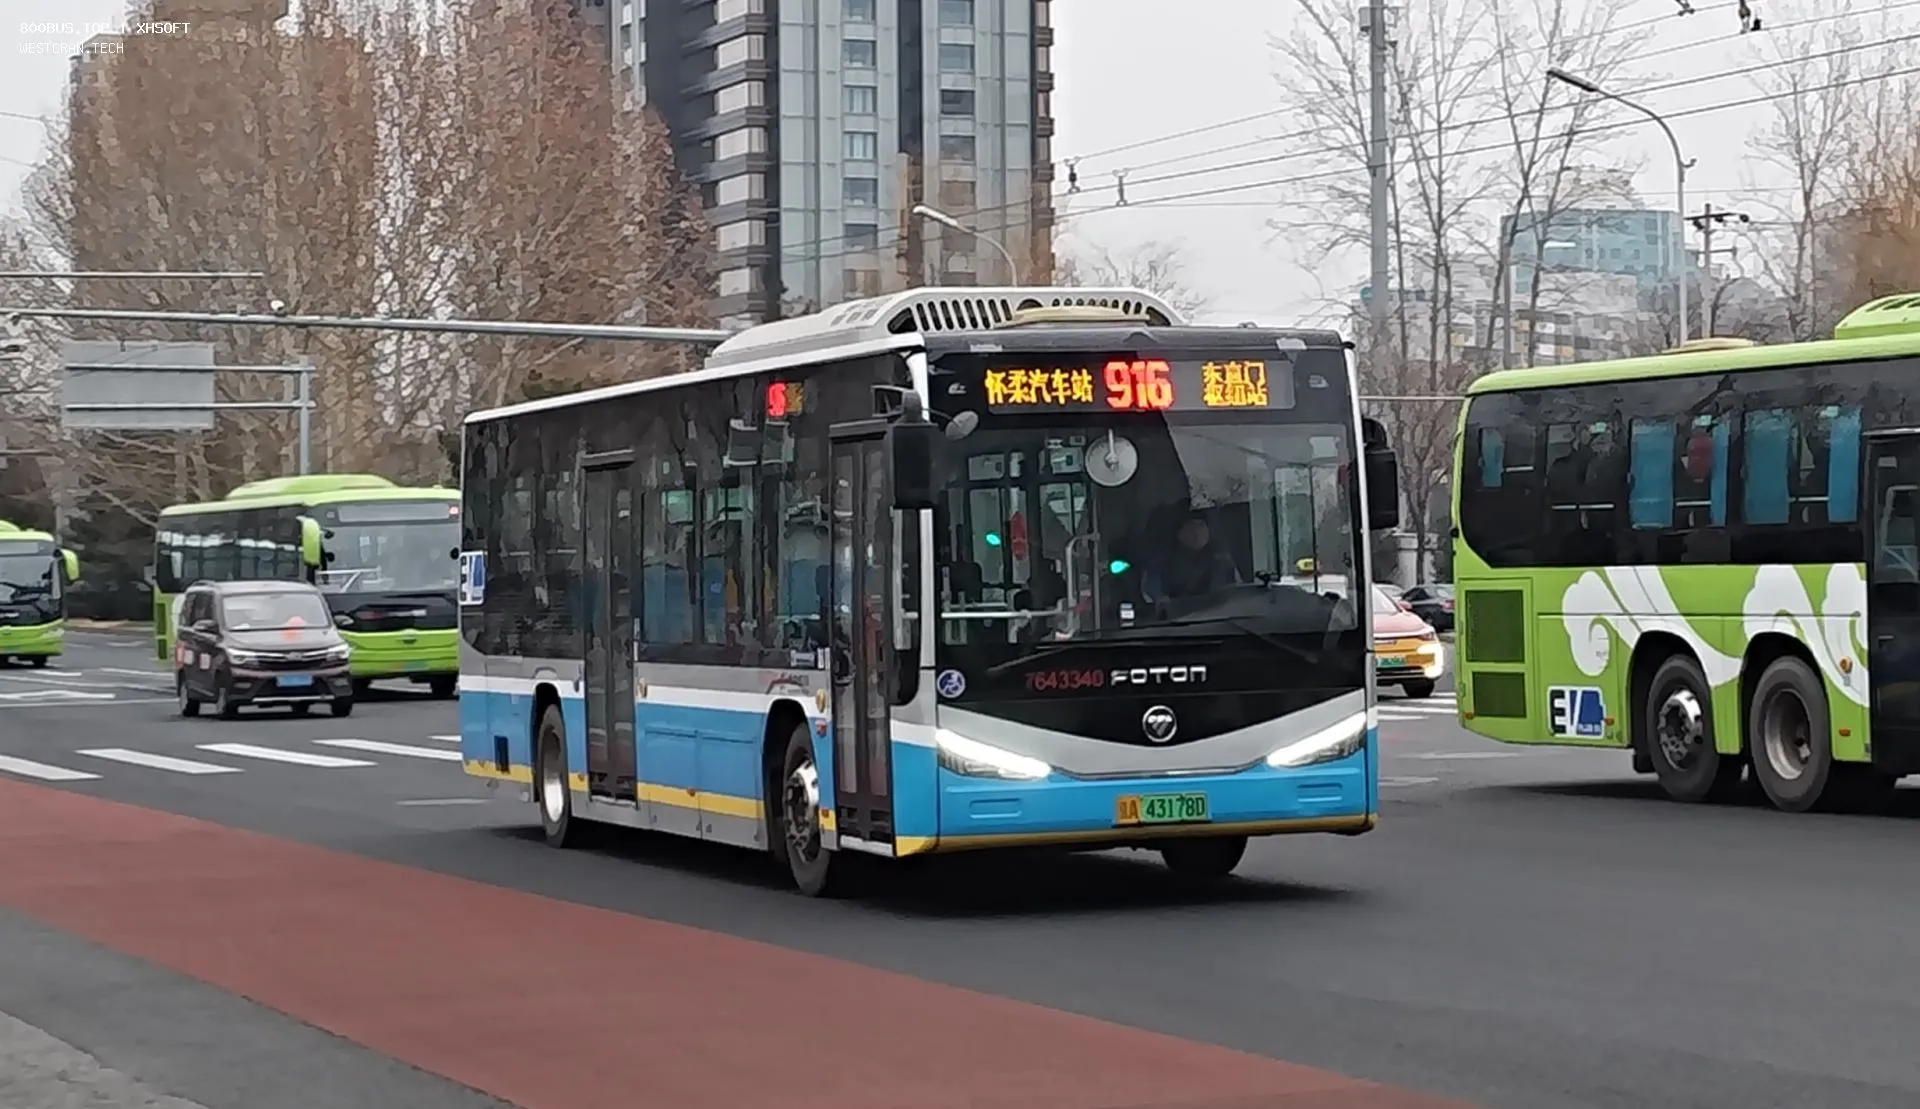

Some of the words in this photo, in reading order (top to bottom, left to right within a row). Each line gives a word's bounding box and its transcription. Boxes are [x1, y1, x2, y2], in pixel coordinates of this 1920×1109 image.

[985, 368, 1093, 404] 怀柔汽车站
[1104, 361, 1174, 408] 916
[1026, 670, 1104, 690] 7643340
[1111, 666, 1206, 685] FOTON
